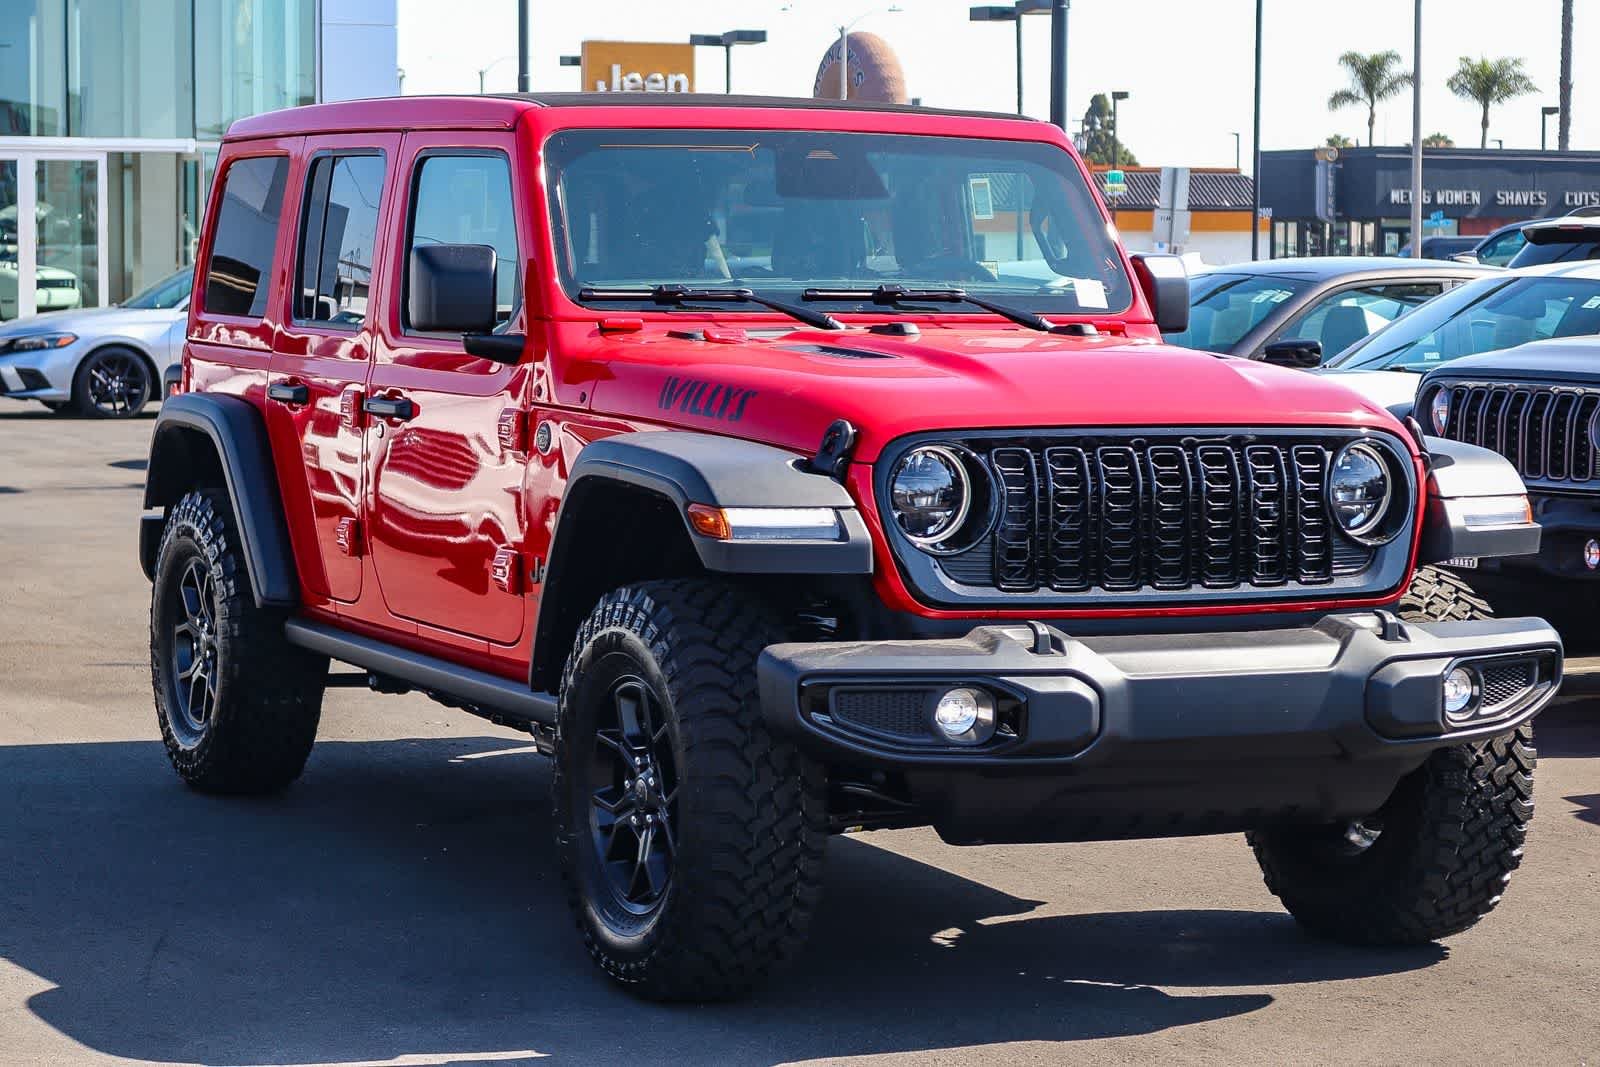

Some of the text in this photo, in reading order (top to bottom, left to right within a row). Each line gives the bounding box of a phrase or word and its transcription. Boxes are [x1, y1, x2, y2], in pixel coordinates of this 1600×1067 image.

[1436, 190, 1481, 206] WOMEN
[1495, 190, 1548, 206] SHAVES
[1564, 191, 1600, 206] CUTS
[657, 375, 758, 423] WILLYS
